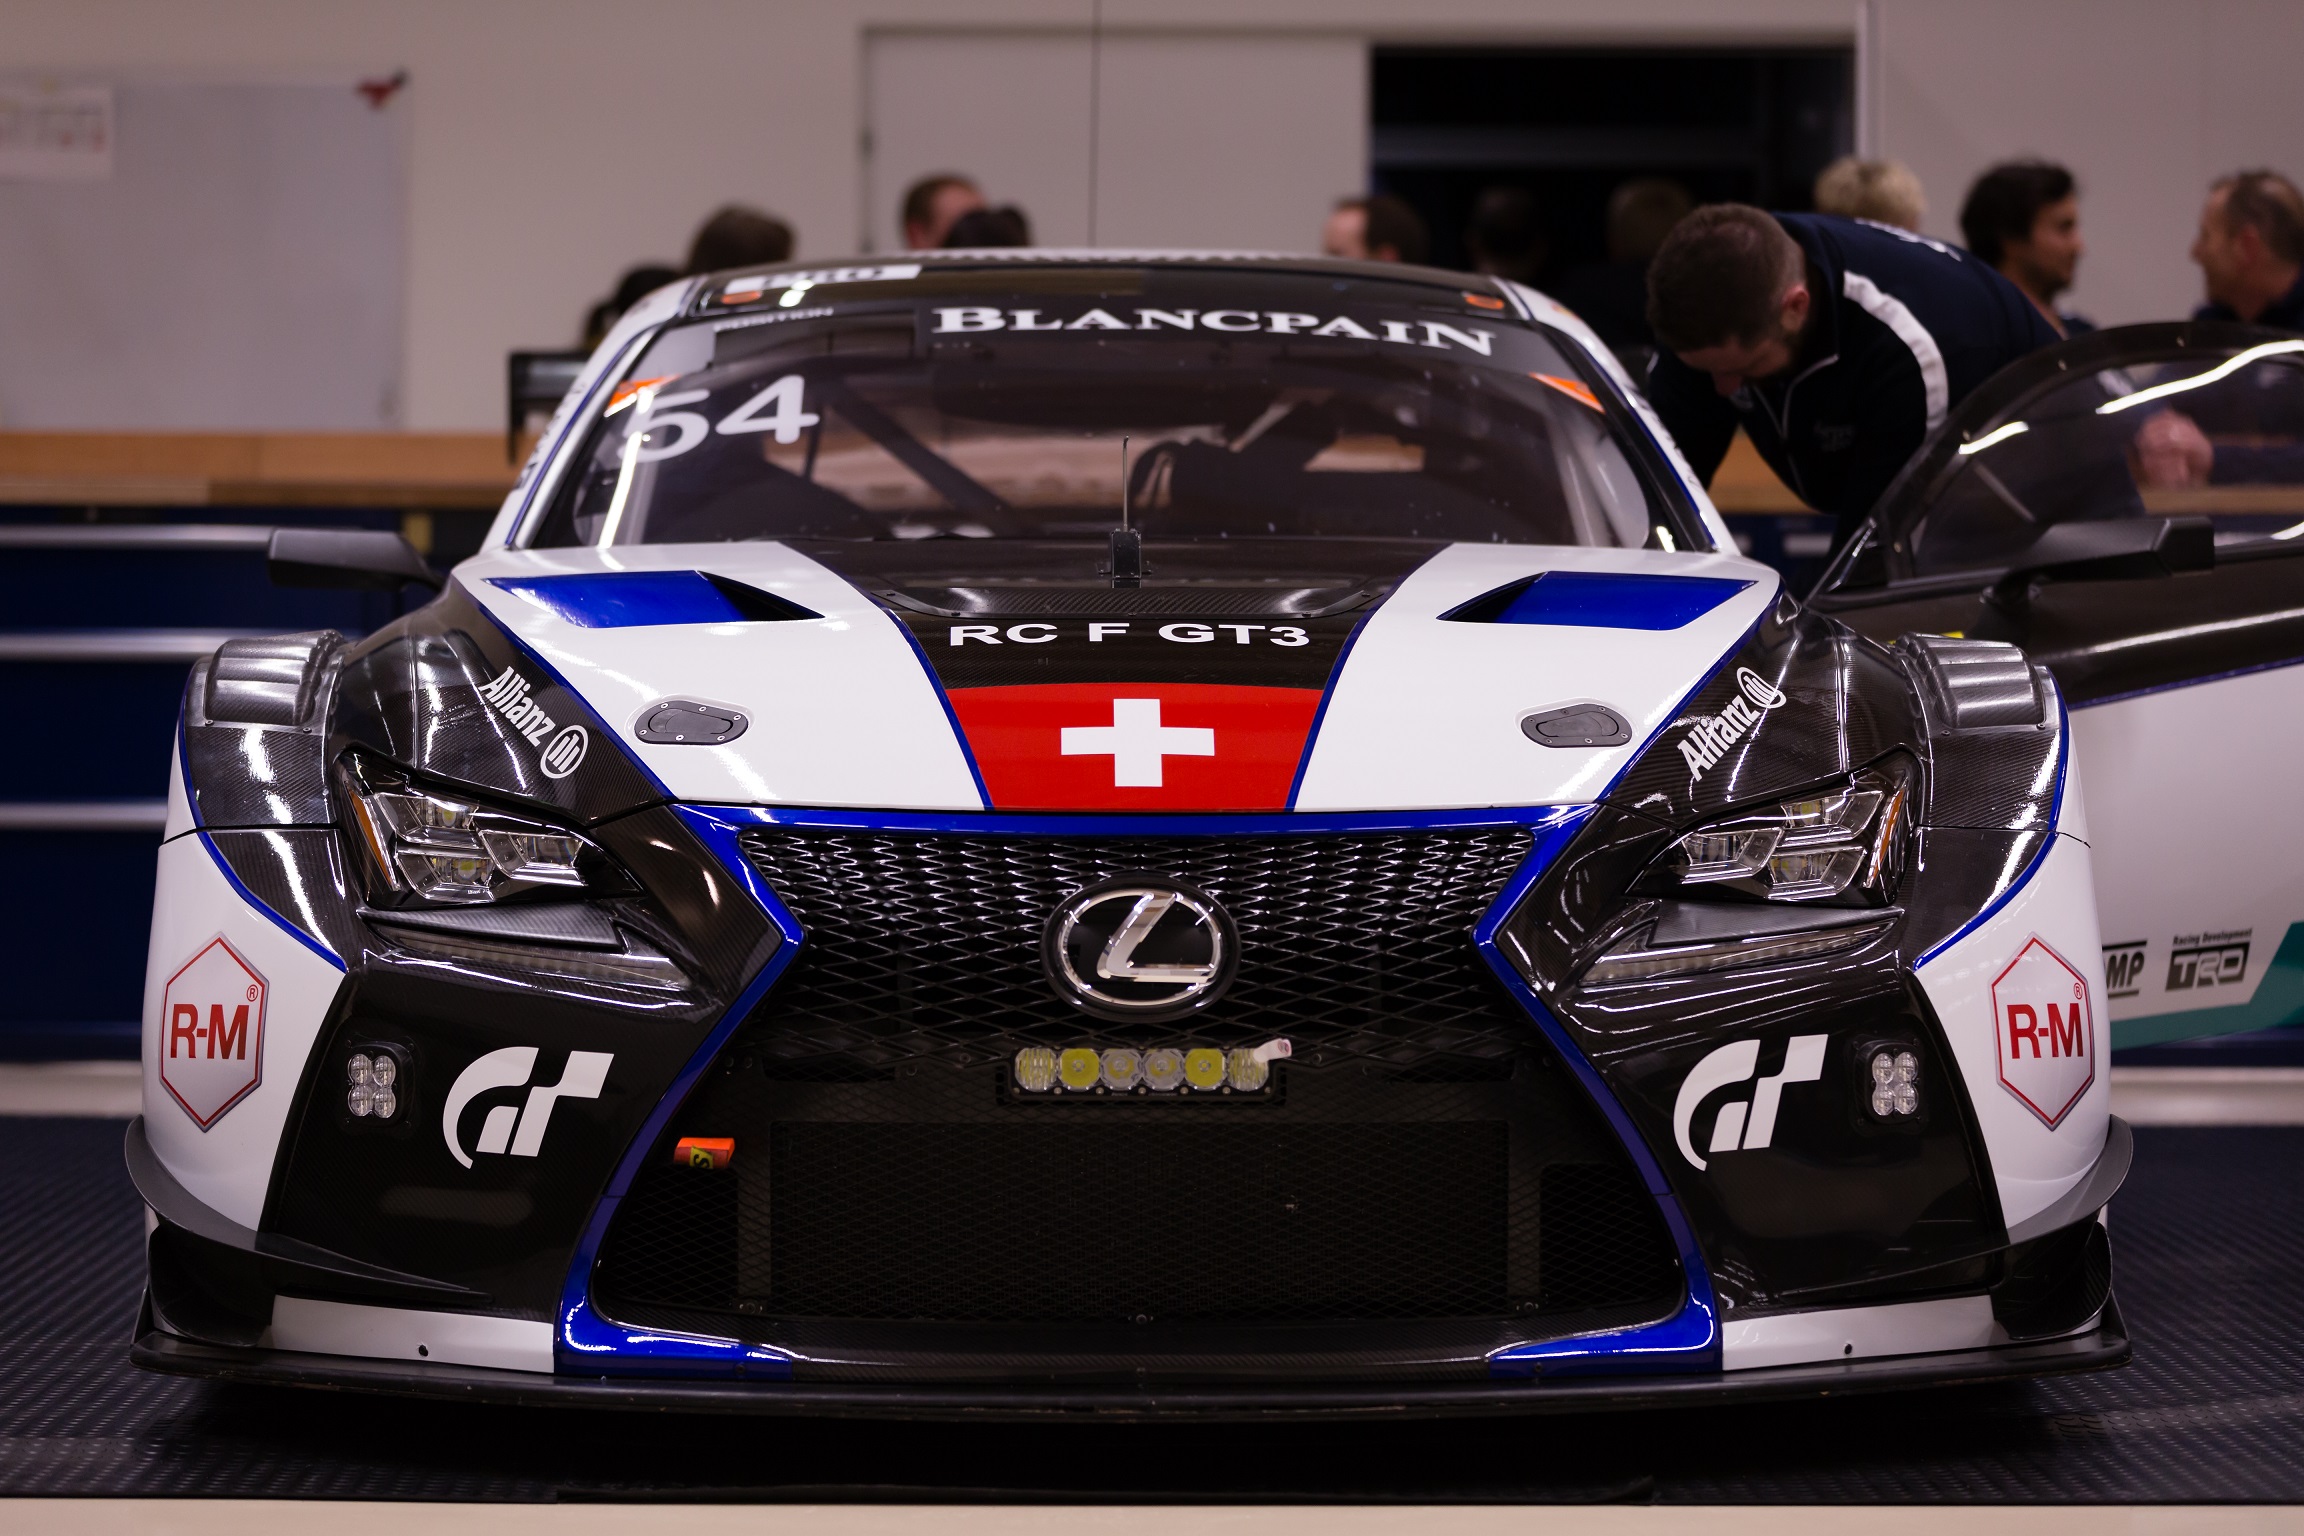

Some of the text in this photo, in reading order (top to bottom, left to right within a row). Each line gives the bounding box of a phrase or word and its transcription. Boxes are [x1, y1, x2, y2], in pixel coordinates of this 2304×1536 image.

[932, 307, 1496, 356] BLANCPAIN
[617, 374, 820, 463] 54
[950, 622, 1310, 647] RC F GT3
[478, 665, 556, 748] Allianz
[1677, 694, 1761, 782] Allianz
[2172, 927, 2253, 948] Racing Development
[2104, 951, 2145, 989] MP
